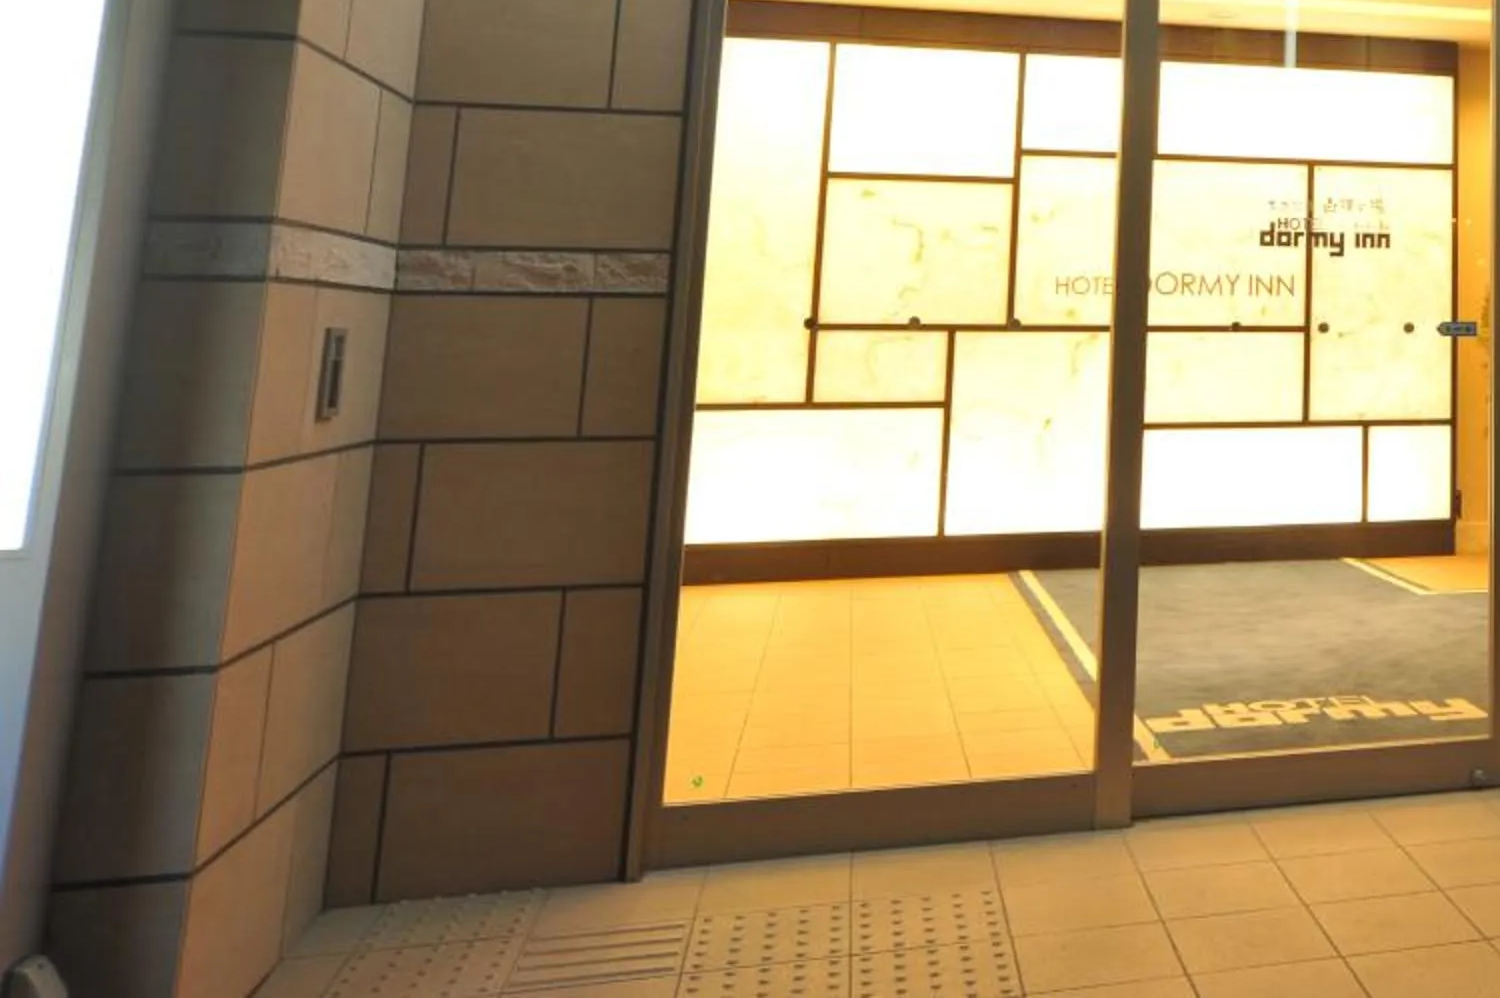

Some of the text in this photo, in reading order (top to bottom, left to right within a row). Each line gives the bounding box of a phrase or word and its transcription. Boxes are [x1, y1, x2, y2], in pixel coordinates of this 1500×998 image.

[1259, 221, 1345, 258] dormy
[1354, 232, 1391, 249] inn
[1055, 271, 1295, 297] HOTE ORMY INN
